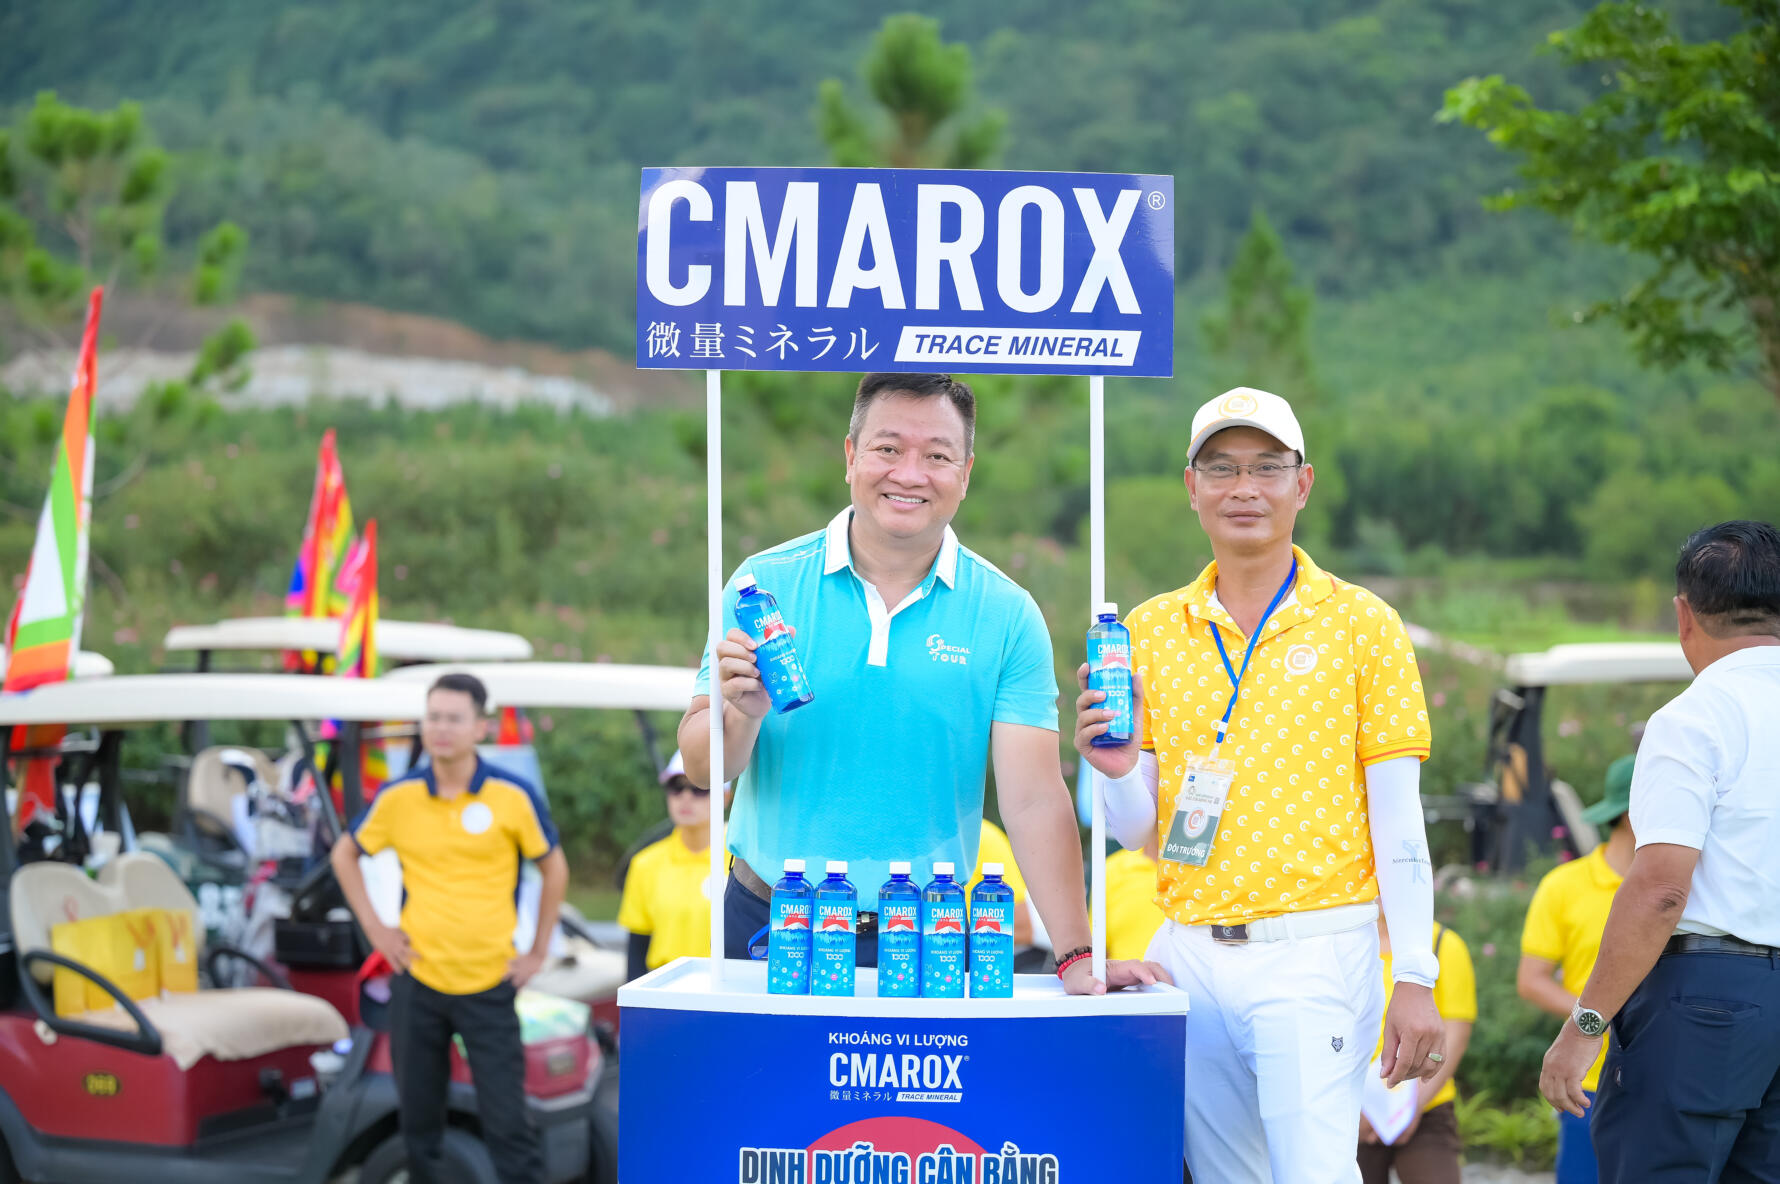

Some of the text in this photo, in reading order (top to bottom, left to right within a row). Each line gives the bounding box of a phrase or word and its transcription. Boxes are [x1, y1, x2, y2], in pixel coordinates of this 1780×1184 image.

[645, 321, 880, 361] 微量ミネラル
[914, 333, 1124, 358] TRACE MINERAL
[819, 905, 853, 917] CMAROX
[884, 905, 917, 917] CMAROX
[931, 907, 964, 919] CMAROX
[972, 907, 1005, 919] CMAROX
[787, 951, 805, 959] 1000
[826, 953, 844, 961] 1000
[892, 953, 910, 961] 1000
[940, 955, 957, 963] 1000
[978, 954, 996, 963] 1000
[828, 1030, 968, 1049] KHOÁNG VI LƯỢNG
[741, 1143, 1057, 1184] DINH DƯỠNG CÂN BẰNG
